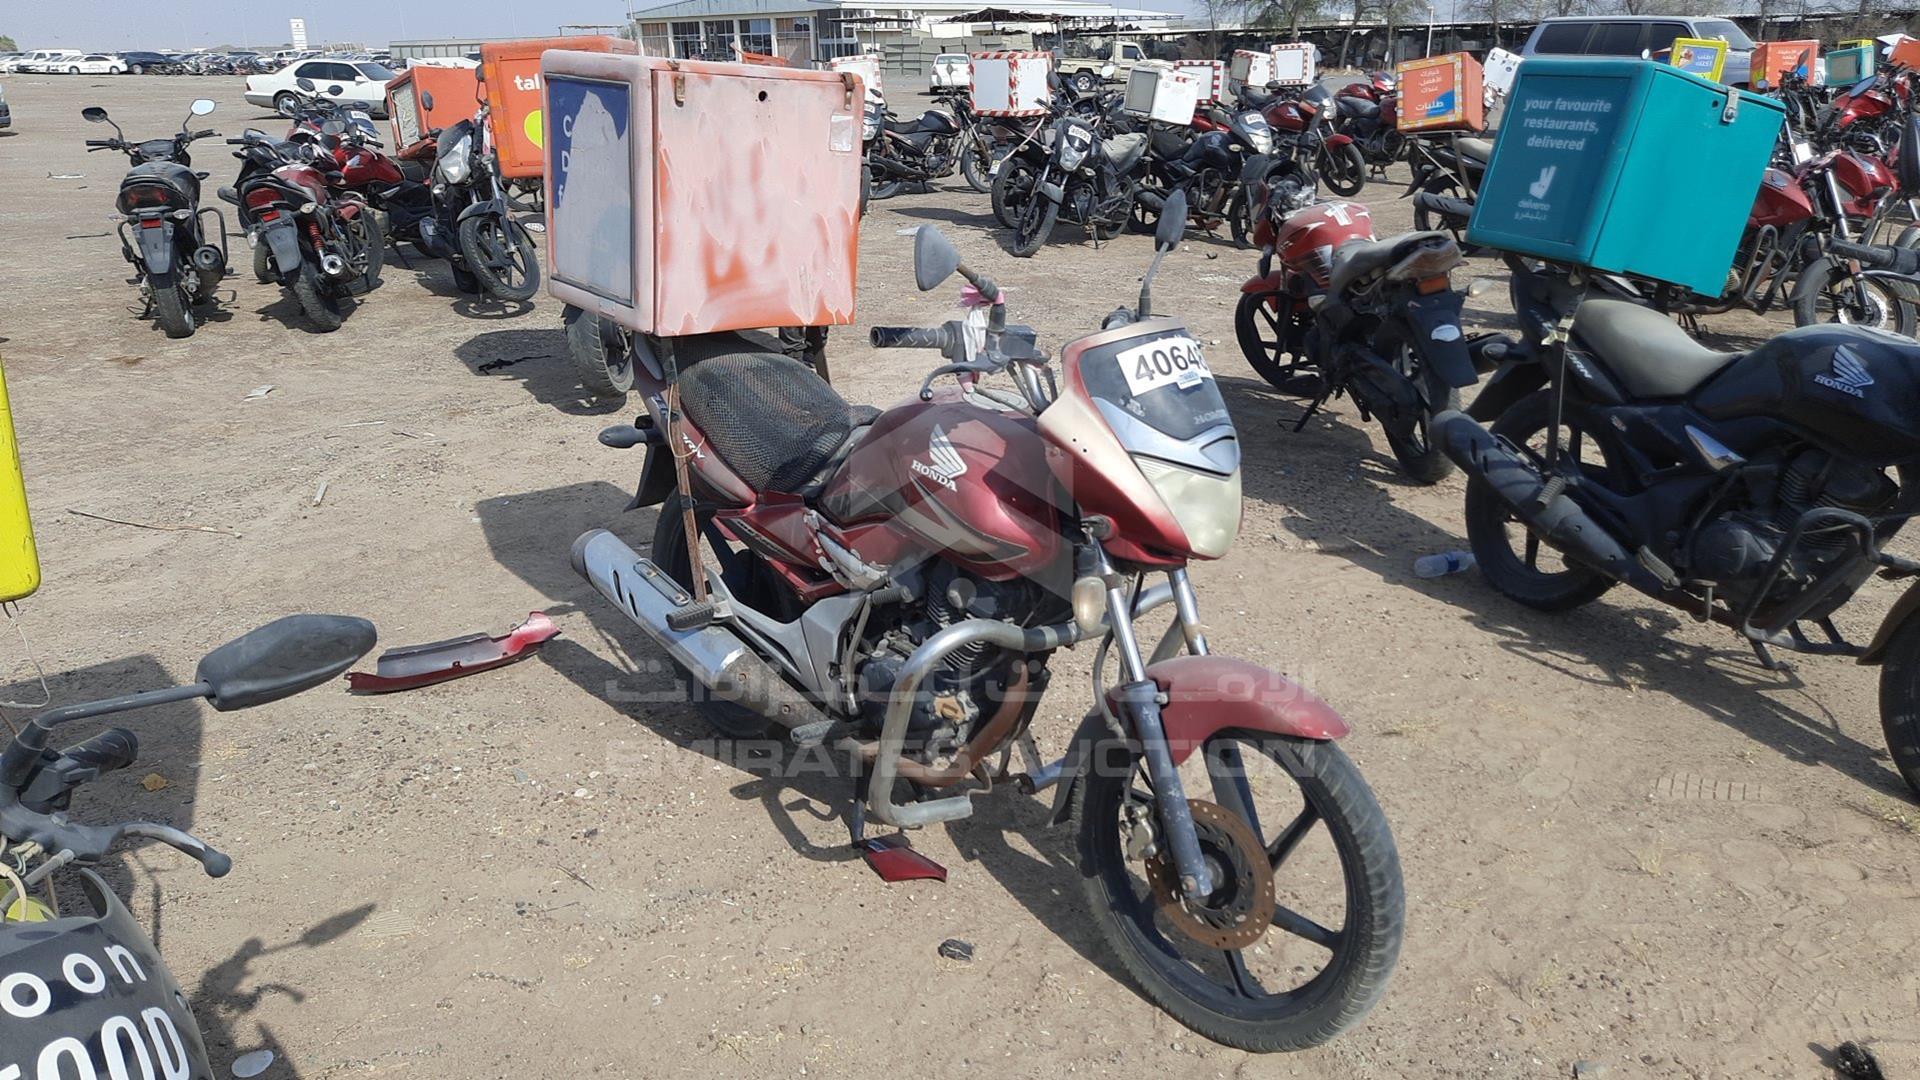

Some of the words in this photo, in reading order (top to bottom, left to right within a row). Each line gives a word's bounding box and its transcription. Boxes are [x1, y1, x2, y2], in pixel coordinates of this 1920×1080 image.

[1523, 98, 1553, 112] your
[1554, 98, 1612, 113] favourite
[1523, 117, 1599, 134] restaurants,
[1527, 135, 1585, 151] delivered
[1813, 374, 1865, 399] HONDA
[911, 459, 958, 493] HONDA
[0, 1006, 191, 1080] OOD
